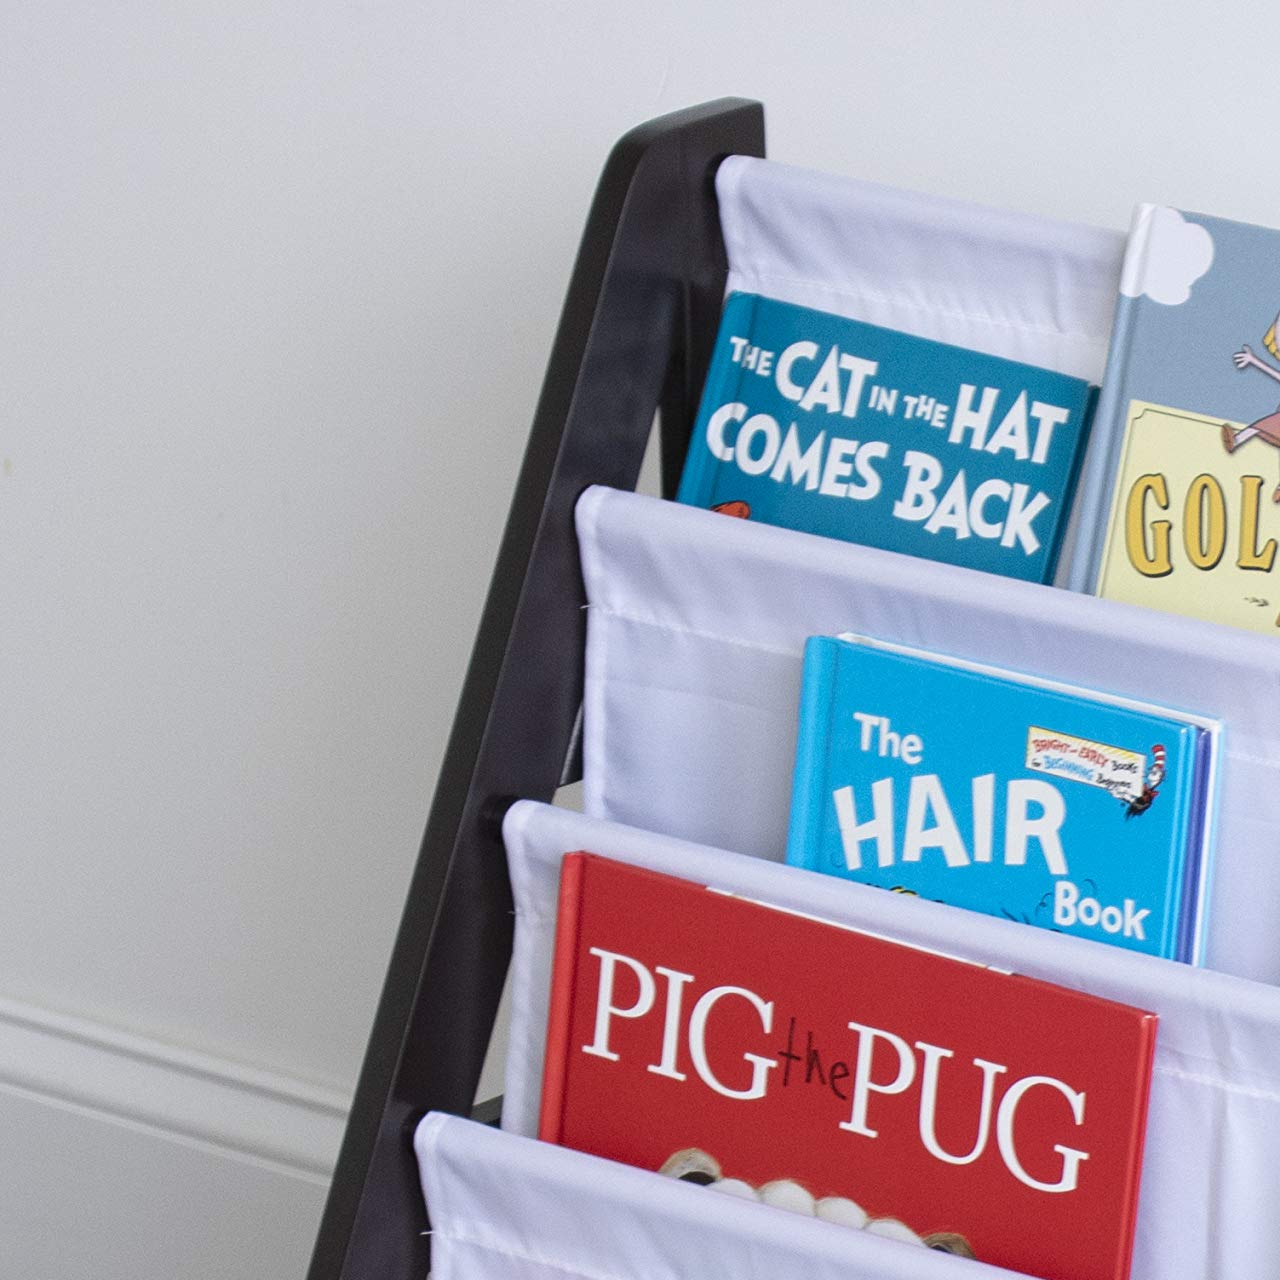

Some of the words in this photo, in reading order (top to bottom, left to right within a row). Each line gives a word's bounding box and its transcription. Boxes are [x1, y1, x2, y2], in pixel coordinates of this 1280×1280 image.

[729, 335, 774, 376] THE
[775, 341, 877, 418] CAT
[869, 385, 898, 415] IN
[903, 394, 949, 428] THE
[948, 384, 1069, 464] HAT
[706, 402, 889, 500] COMES
[893, 451, 1051, 556] BACK
[853, 711, 923, 765] The
[832, 773, 1069, 875] HAIR
[1053, 880, 1150, 941] Book
[582, 946, 777, 1100] PIG
[778, 1017, 849, 1100] the
[839, 1021, 1089, 1193] PUG
